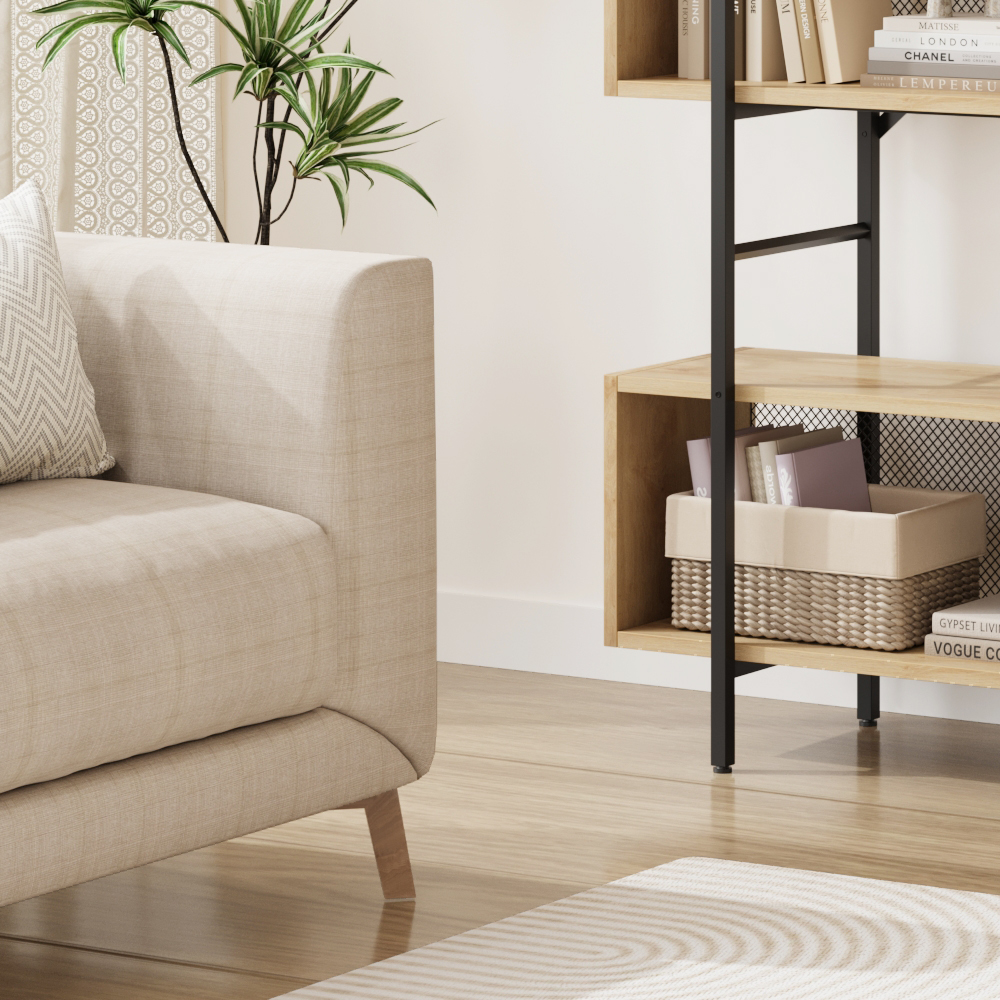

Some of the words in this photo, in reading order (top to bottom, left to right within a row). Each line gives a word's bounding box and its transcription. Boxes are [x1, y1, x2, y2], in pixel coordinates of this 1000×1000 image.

[801, 13, 811, 39] DESIGN
[918, 21, 960, 31] MATISSE
[920, 36, 979, 47] LONDON
[904, 51, 954, 62] CHANEL
[939, 618, 976, 632] GYPSET
[933, 640, 981, 659] VOGUE
